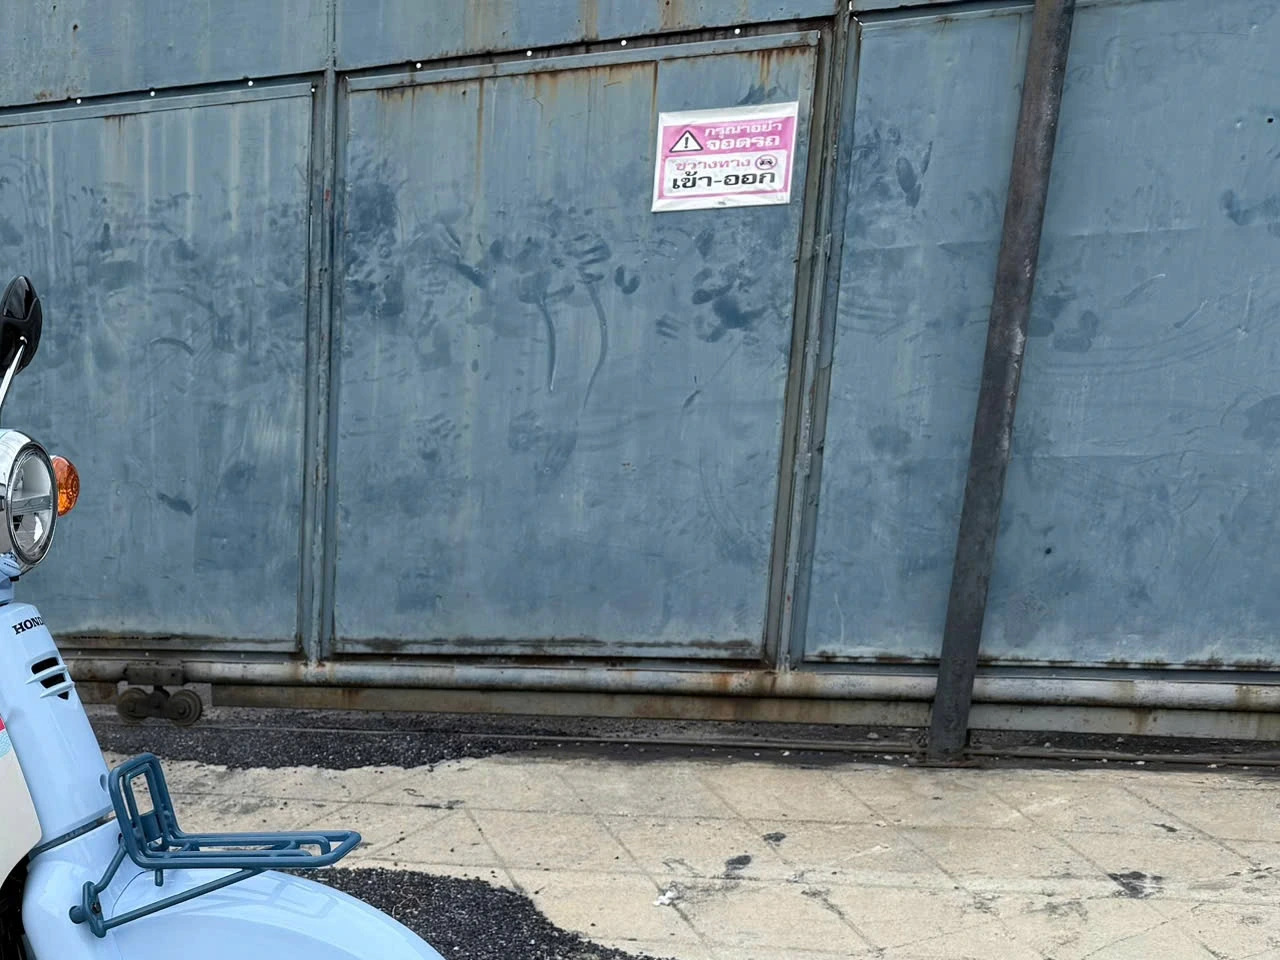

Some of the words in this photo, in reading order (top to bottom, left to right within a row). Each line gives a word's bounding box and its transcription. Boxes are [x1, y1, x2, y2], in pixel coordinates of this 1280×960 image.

[704, 121, 783, 138] กรุณาอย่า
[706, 135, 780, 150] จอดรถ
[675, 157, 751, 171] ขวางทาง
[672, 171, 775, 189] เข้า-ออก
[12, 616, 45, 635] HOND
